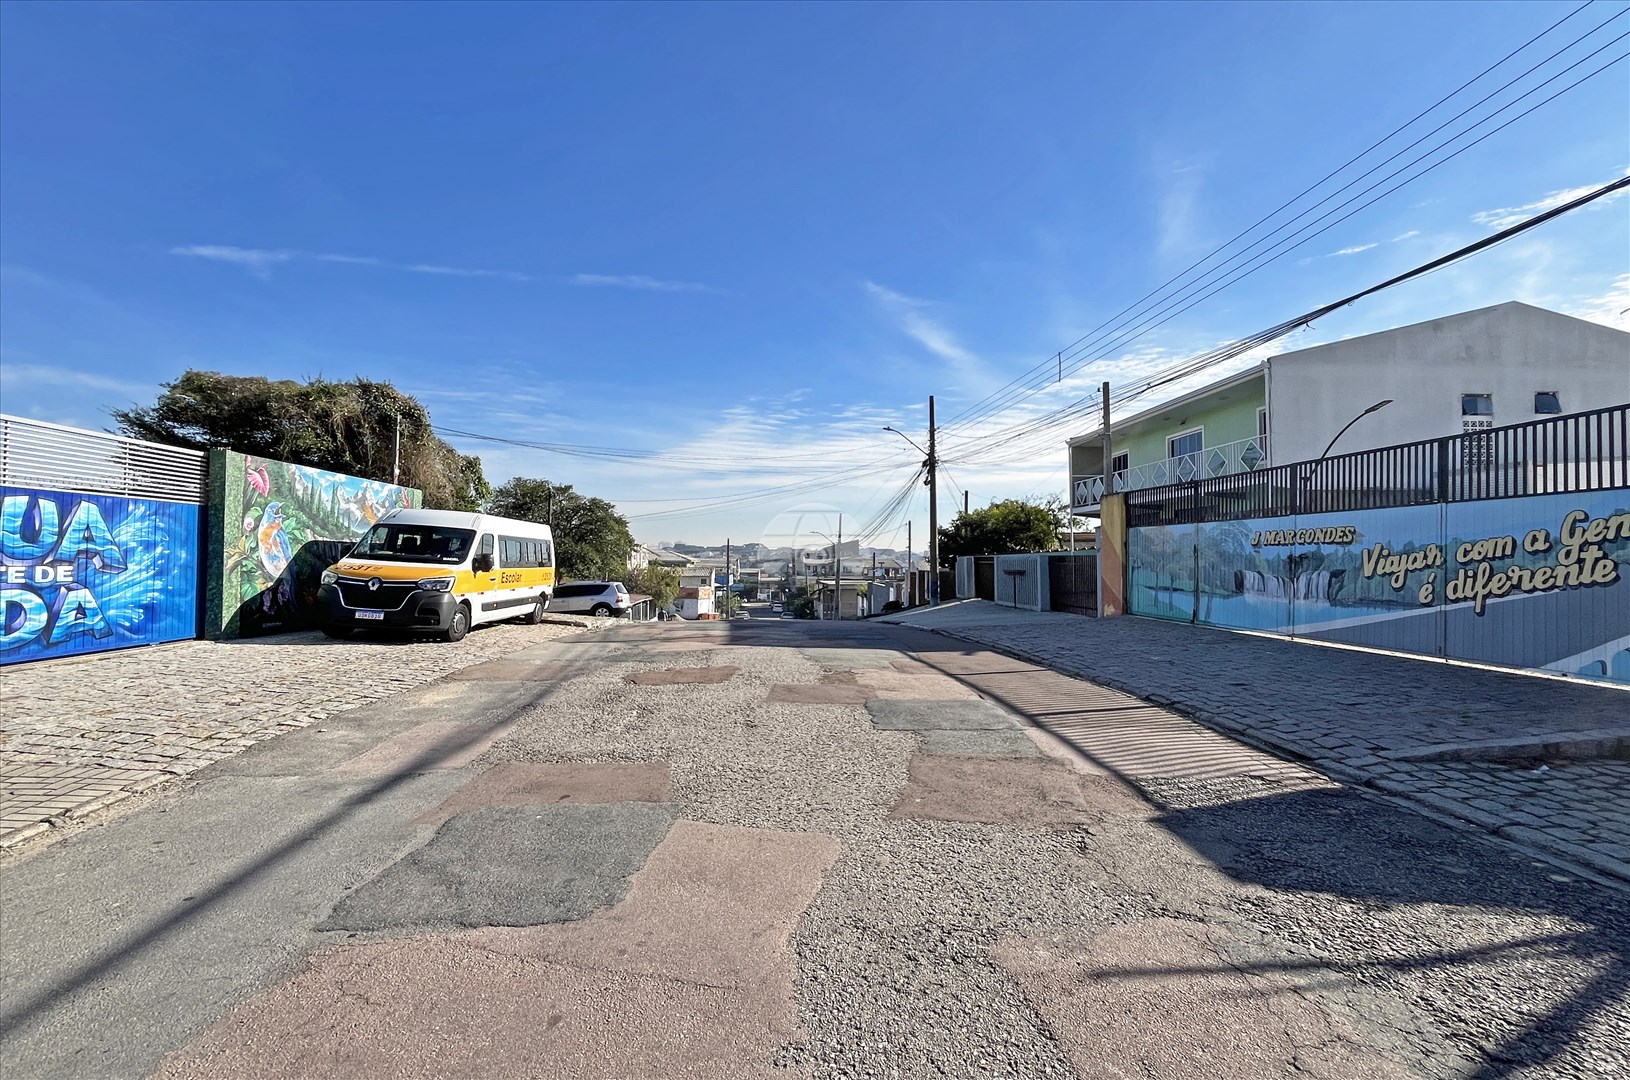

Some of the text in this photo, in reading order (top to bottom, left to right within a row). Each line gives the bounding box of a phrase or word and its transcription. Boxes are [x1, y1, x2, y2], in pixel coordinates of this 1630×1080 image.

[1251, 531, 1261, 546] J
[1456, 535, 1515, 564] com
[1523, 528, 1551, 554] a
[34, 565, 74, 583] DE
[500, 571, 522, 584] Escolar
[1418, 545, 1619, 615] é diferente
